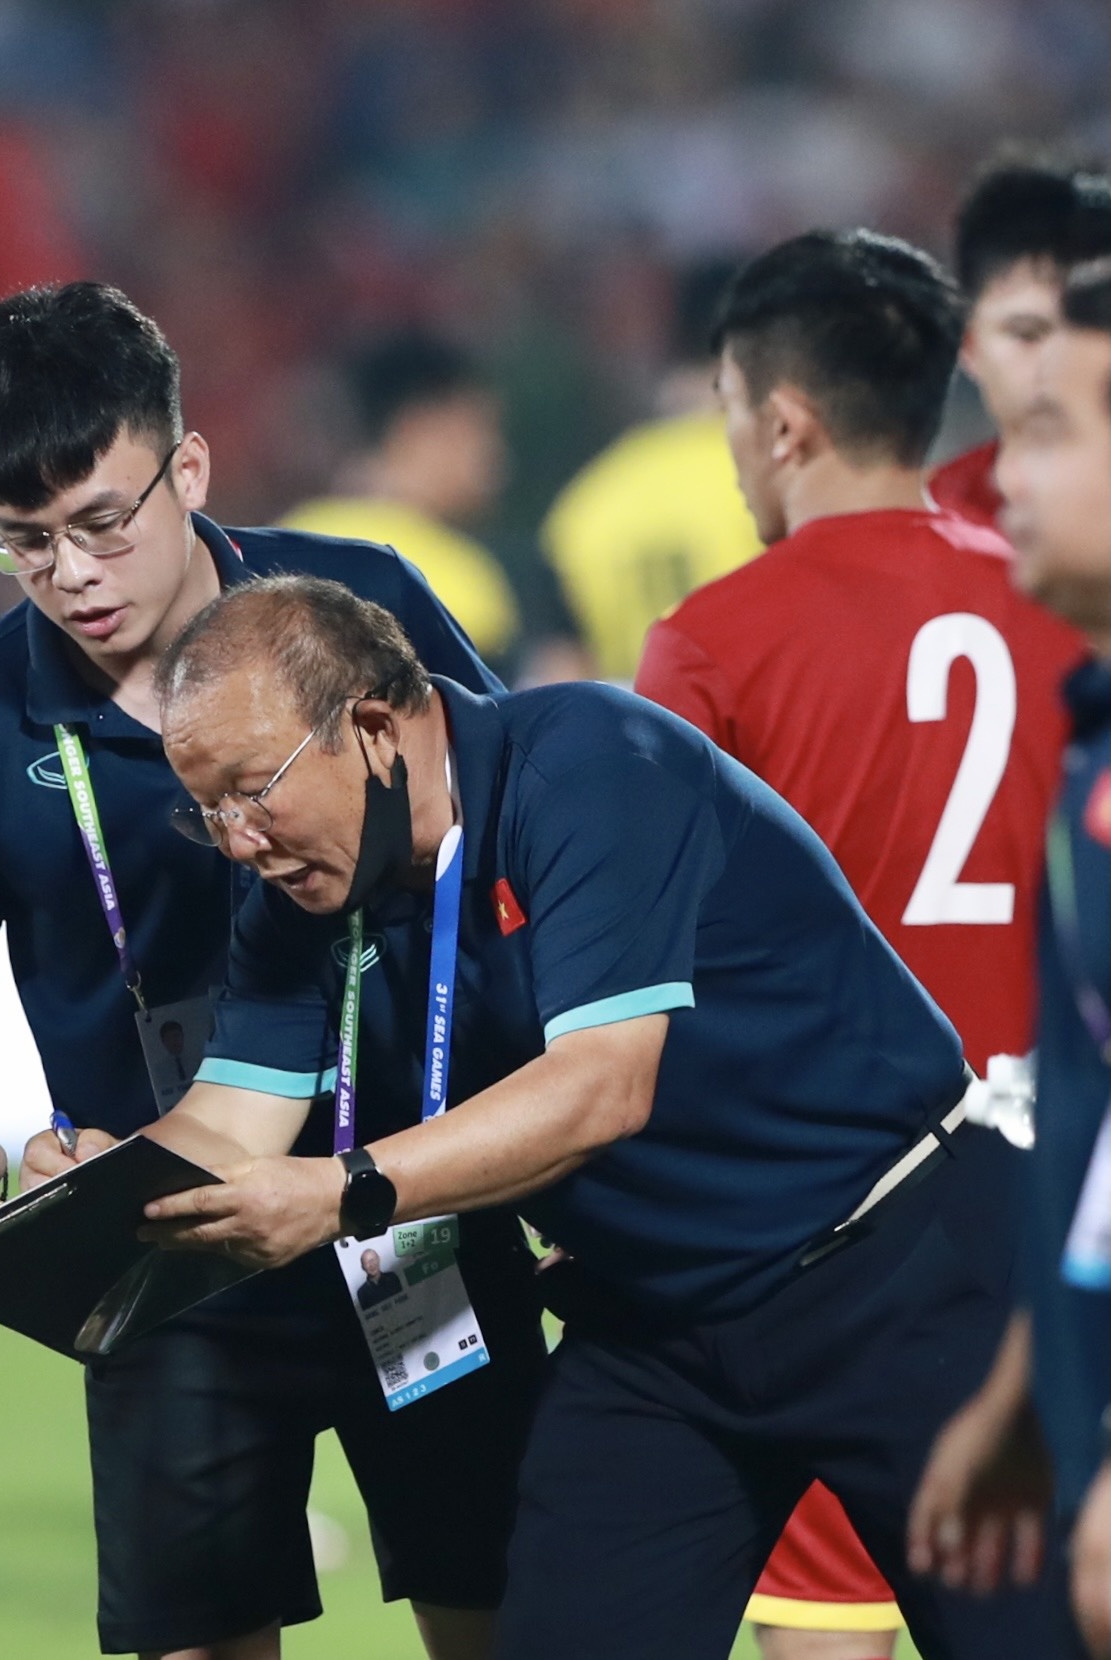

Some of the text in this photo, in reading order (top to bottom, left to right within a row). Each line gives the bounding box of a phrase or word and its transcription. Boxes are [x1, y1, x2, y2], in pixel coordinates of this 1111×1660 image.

[901, 612, 1018, 926] 2
[73, 779, 106, 871] SOUTHEAST
[98, 873, 116, 911] ASIA
[341, 990, 356, 1087] SOUTHEAST
[433, 1014, 446, 1044] SEA
[429, 1047, 445, 1101] GAMES
[338, 1088, 351, 1128] ASIA
[397, 1230, 418, 1240] Zone
[401, 1239, 416, 1249] 1+2
[430, 1226, 452, 1245] 19
